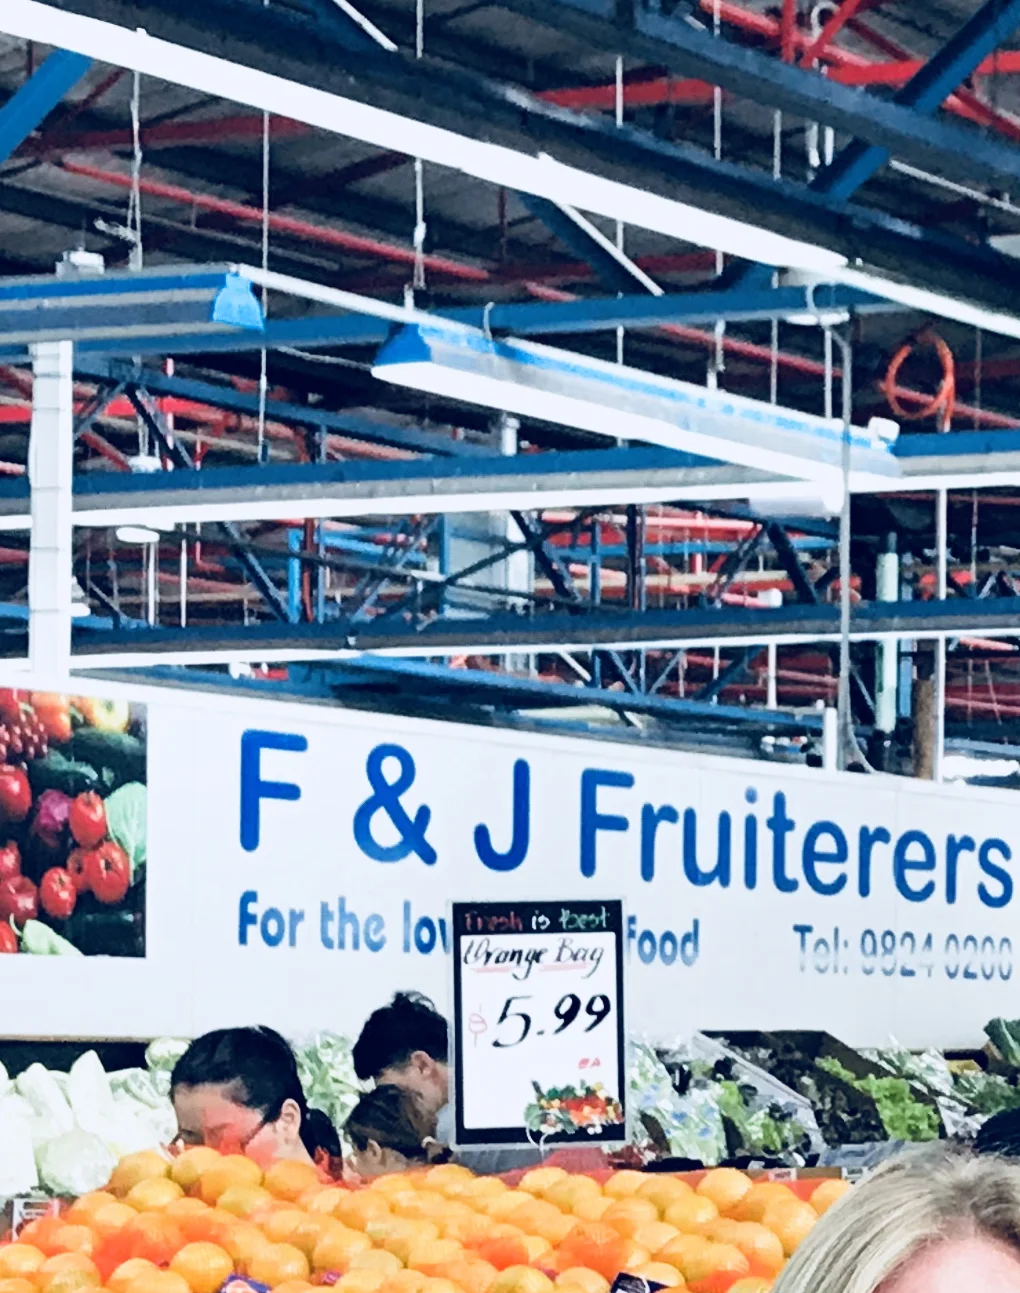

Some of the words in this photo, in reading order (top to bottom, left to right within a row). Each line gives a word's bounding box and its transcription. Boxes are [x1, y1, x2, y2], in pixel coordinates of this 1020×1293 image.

[240, 729, 308, 852] F
[353, 743, 437, 865] &
[474, 759, 530, 872] J
[579, 767, 1014, 908] Fruiterers
[320, 896, 387, 953] the
[531, 909, 550, 930] is
[463, 937, 549, 981] Orange
[554, 937, 605, 979] Bag
[793, 924, 848, 975] Tel:
[944, 933, 1012, 980] 0200
